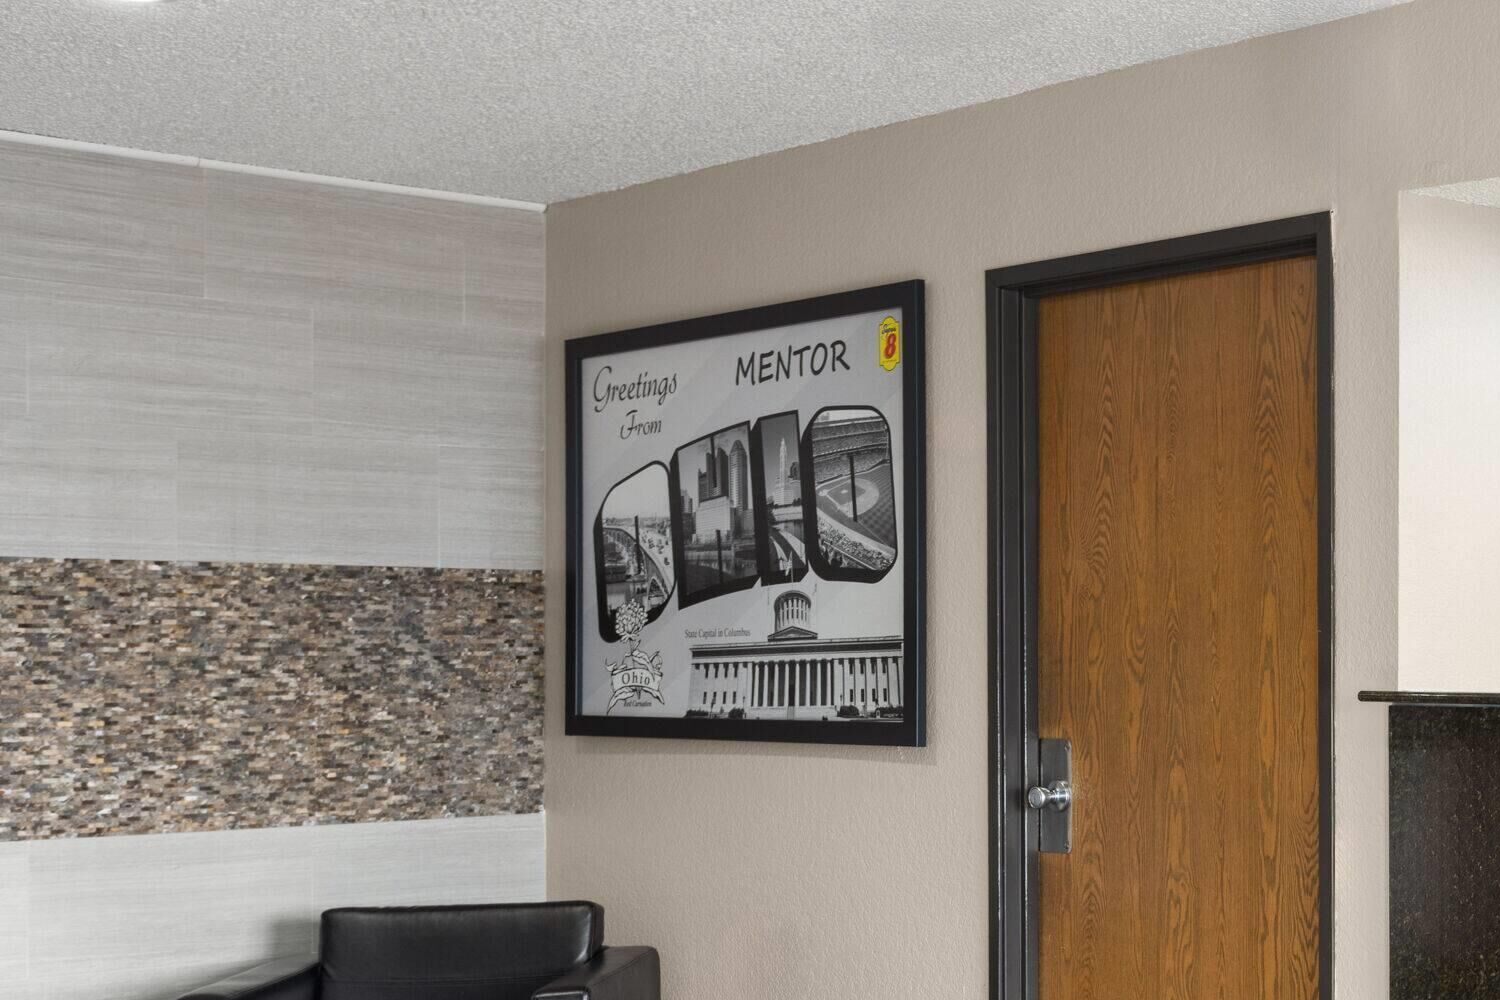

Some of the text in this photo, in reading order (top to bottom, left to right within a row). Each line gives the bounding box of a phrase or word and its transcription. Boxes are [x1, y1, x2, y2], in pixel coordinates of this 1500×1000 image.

[884, 333, 897, 359] 8
[736, 340, 850, 386] MENTOR
[594, 366, 677, 412] Greetings
[620, 409, 662, 440] From
[724, 627, 751, 637] Columbus
[621, 672, 651, 686] Ohio
